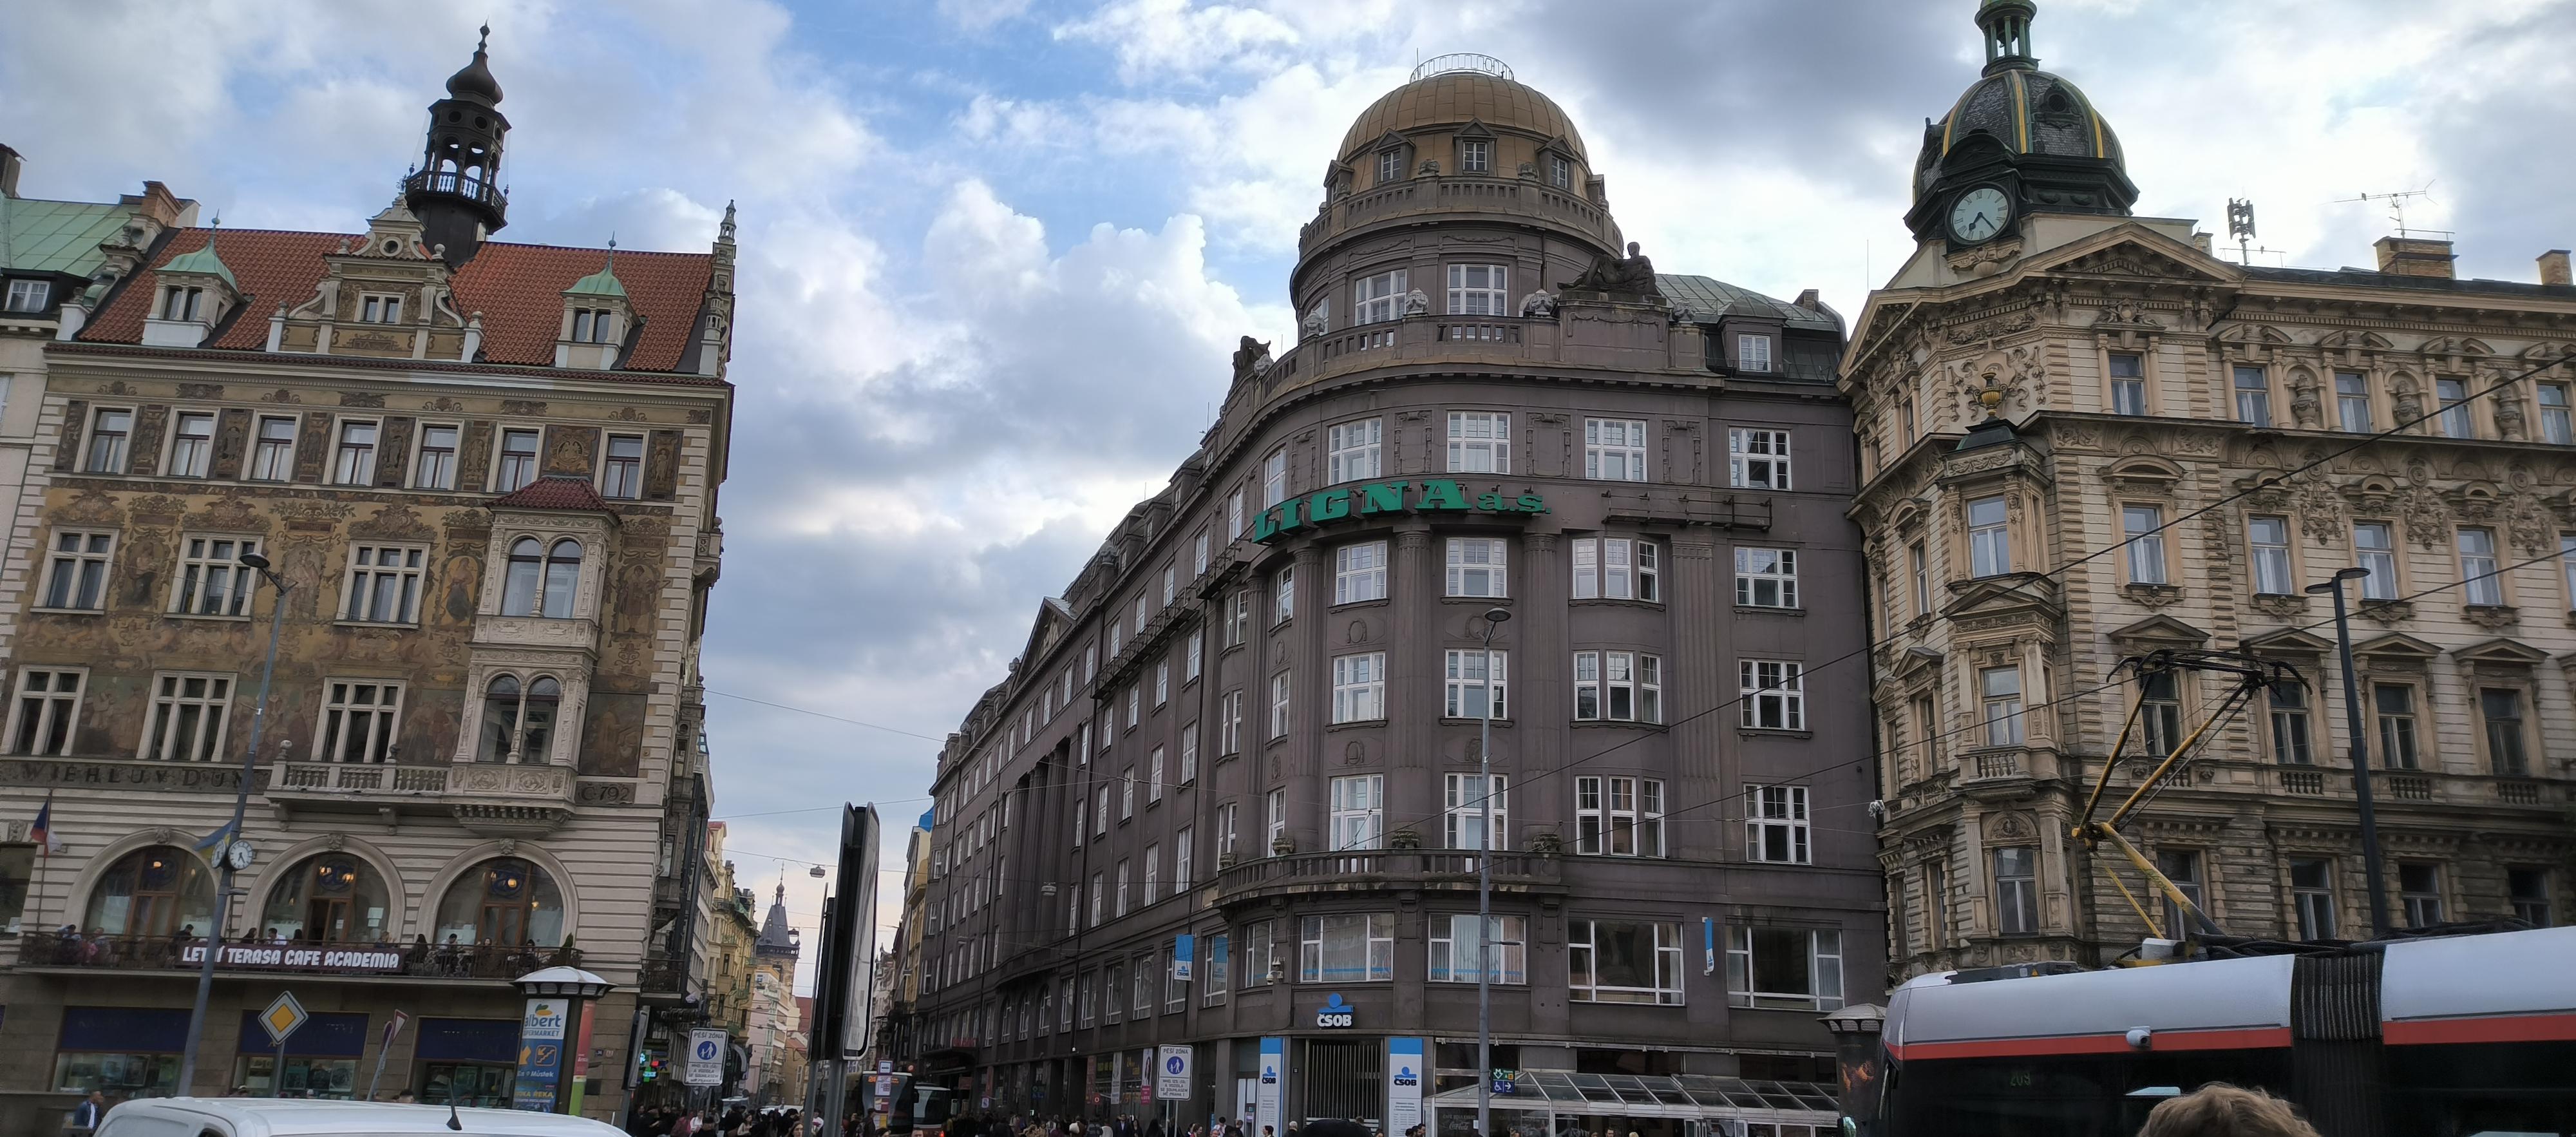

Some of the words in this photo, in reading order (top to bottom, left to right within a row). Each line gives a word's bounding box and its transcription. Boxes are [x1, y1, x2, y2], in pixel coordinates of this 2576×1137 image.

[1253, 479, 1472, 545] LIGNA
[1477, 492, 1552, 514] a.s.
[600, 786, 629, 801] 792
[182, 946, 225, 962] LETÍ
[227, 948, 282, 964] TERASA
[285, 950, 321, 966] CAFE
[323, 951, 400, 968] ACADEMIA
[1317, 1013, 1352, 1027] ČSOB
[1394, 1078, 1417, 1086] ČSOB
